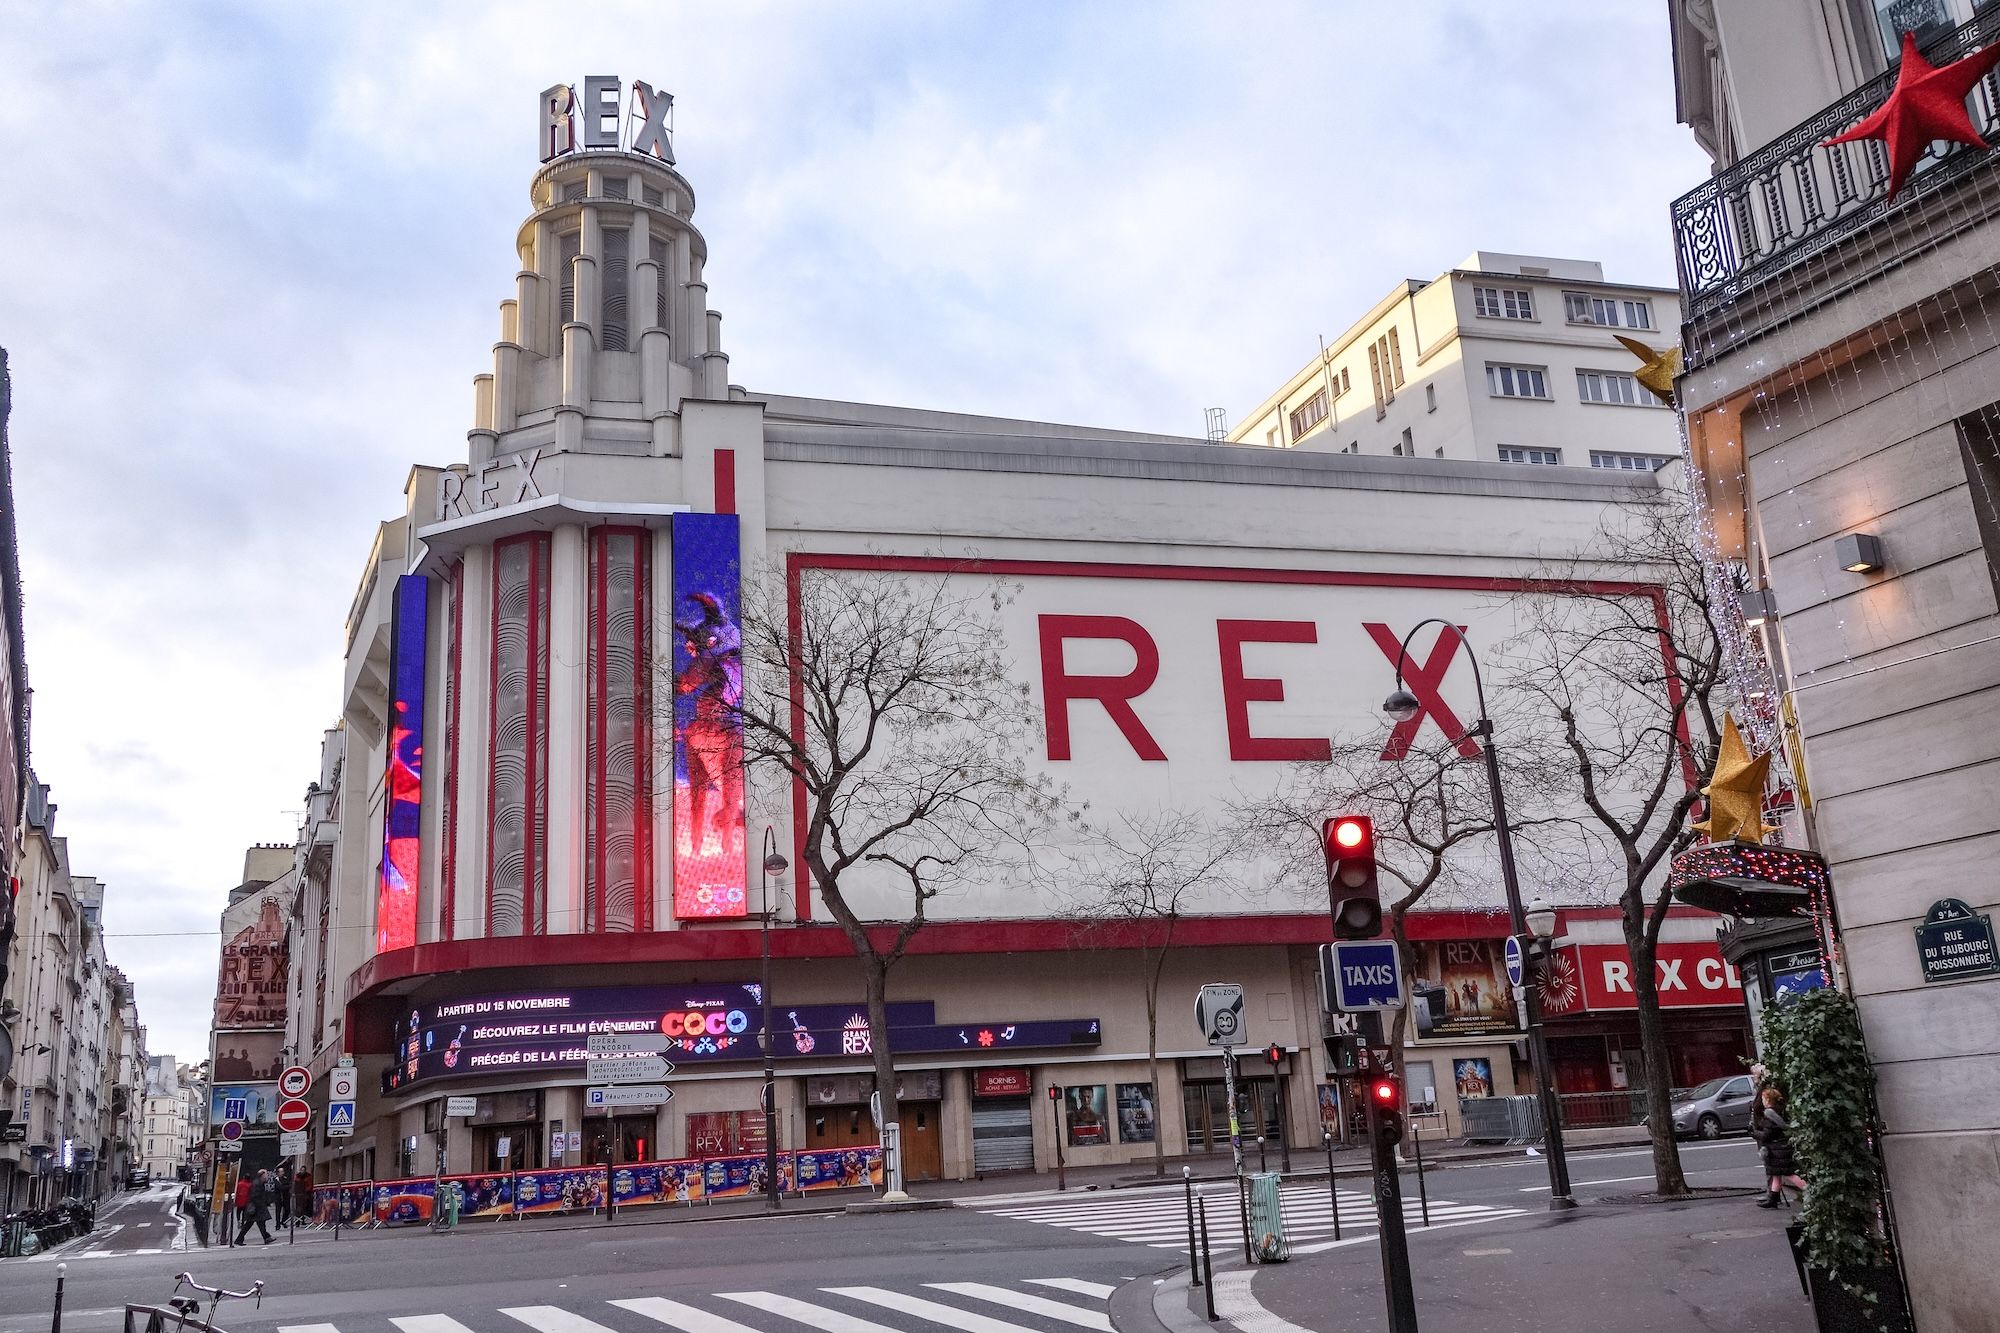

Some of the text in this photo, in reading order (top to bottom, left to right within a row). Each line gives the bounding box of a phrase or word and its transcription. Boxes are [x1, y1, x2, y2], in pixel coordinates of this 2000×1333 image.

[540, 76, 676, 164] REX
[436, 449, 541, 521] REX
[1038, 614, 1484, 761] REX
[261, 896, 280, 905] REX
[1943, 930, 1964, 942] RUE
[223, 945, 237, 957] LE
[1446, 942, 1483, 965] REX
[1925, 940, 1989, 958] DU FAUBOURG
[222, 957, 288, 981] REX
[1928, 952, 1992, 971] POISSONNIÈRE
[1343, 964, 1394, 986] TAXIS
[1602, 959, 1688, 992] RX
[220, 996, 288, 1022] 7 SALLES
[437, 998, 570, 1018] À PARTIR DU 15 NOVEMBRE
[473, 1020, 656, 1039] DÉCOUVREZ LE FILM ÉVÈNEMENT
[661, 1010, 748, 1036] COCO
[1219, 1016, 1233, 1028] 30
[843, 1037, 873, 1054] REX
[471, 1051, 520, 1066] PRÉCÉDÉ
[523, 1051, 538, 1063] DE
[541, 1050, 556, 1061] LA
[988, 1076, 1017, 1085] BORNES
[696, 1136, 723, 1152] REX
